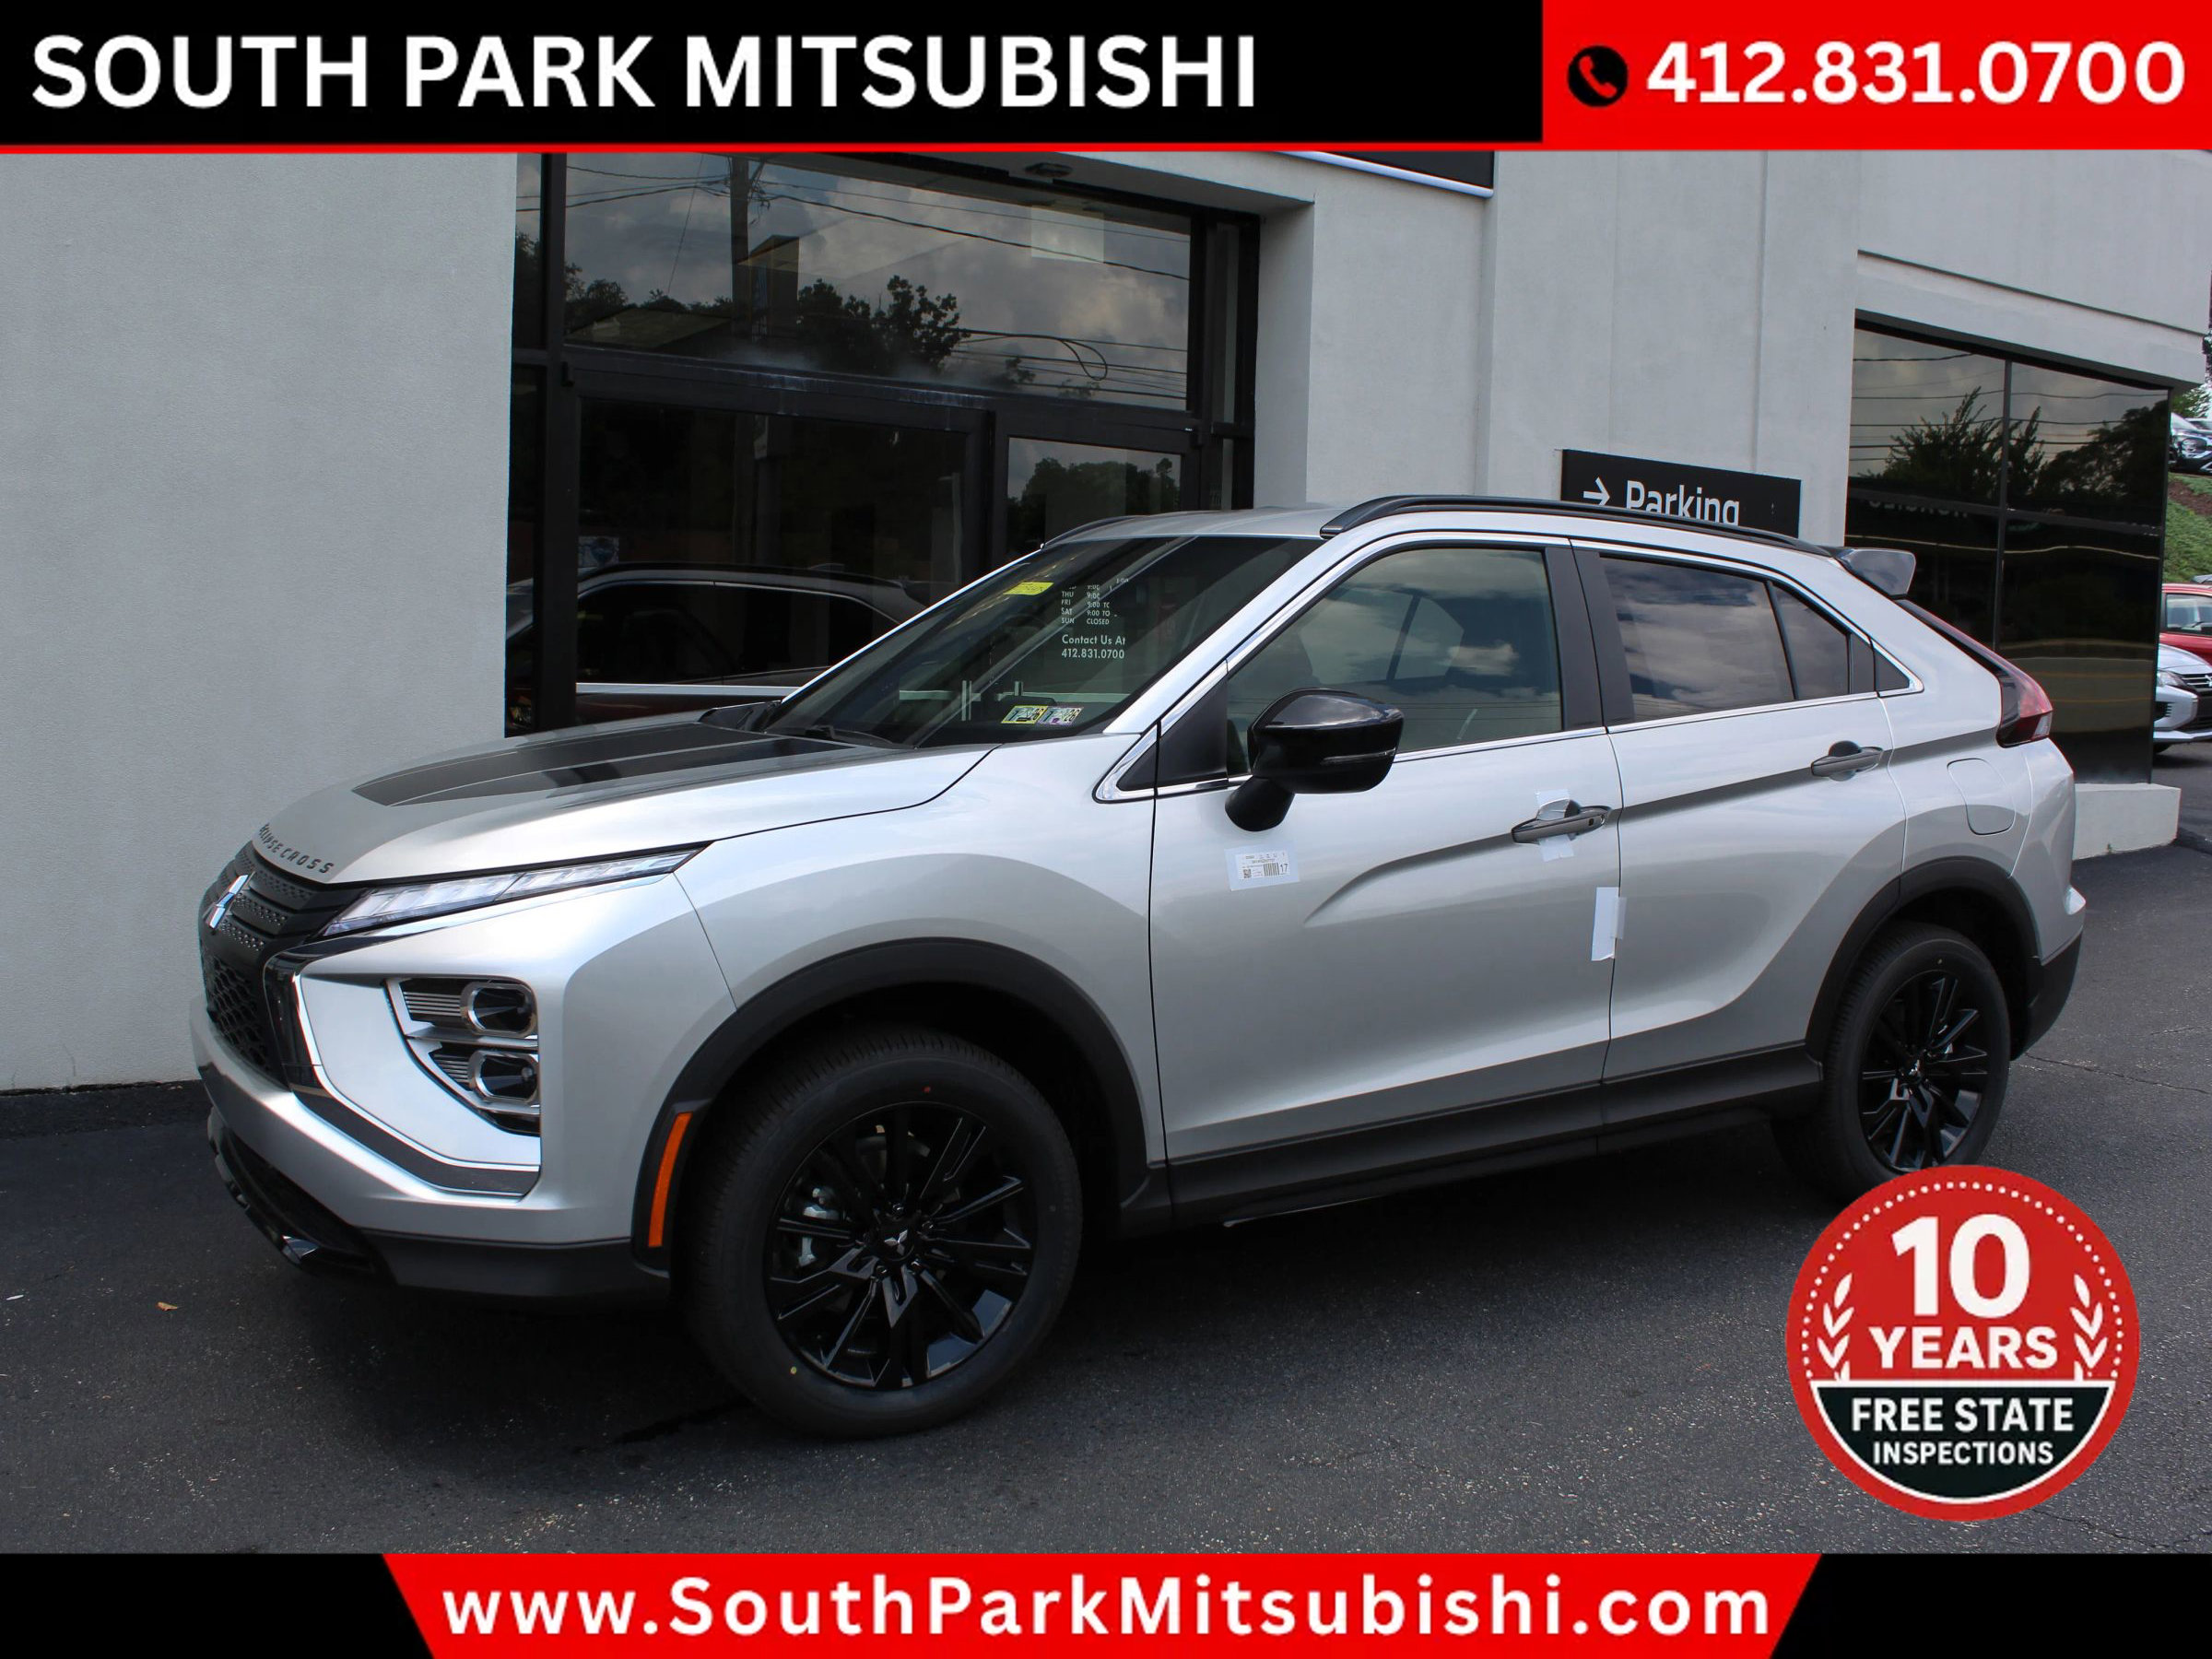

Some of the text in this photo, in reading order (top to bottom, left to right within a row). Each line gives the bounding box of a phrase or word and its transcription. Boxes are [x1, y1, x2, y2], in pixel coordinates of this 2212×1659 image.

[1062, 634, 1126, 645] Contact Us At
[1061, 648, 1125, 659] 412.831.0700
[280, 847, 335, 874] CROSS
